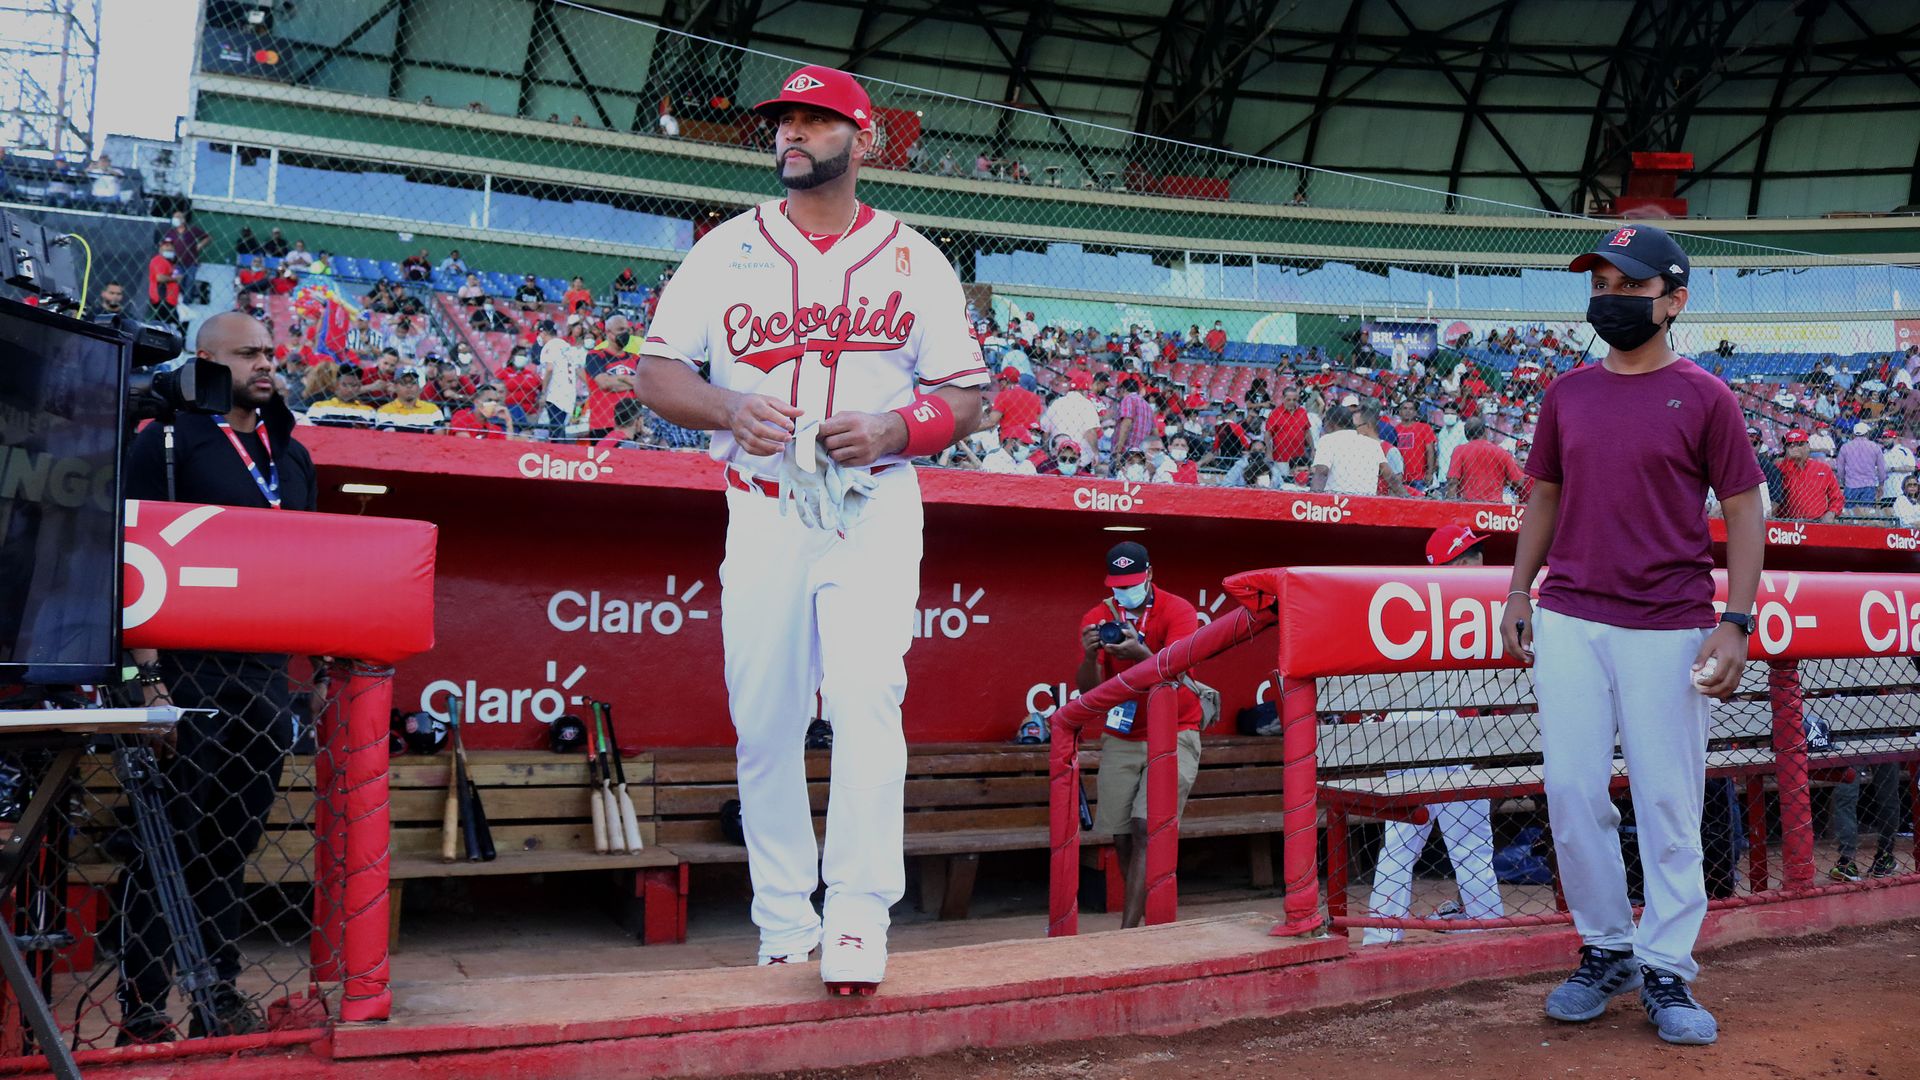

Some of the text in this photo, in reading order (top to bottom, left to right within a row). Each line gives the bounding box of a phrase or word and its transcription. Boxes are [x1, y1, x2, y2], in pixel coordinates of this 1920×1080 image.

[1608, 228, 1636, 247] E
[723, 290, 916, 367] Escogido
[518, 452, 599, 481] Claro
[1073, 487, 1133, 512] Claro
[1291, 499, 1342, 523] Claro
[1475, 510, 1519, 532] Claro
[1768, 527, 1801, 545] Claro
[1886, 533, 1917, 550] Claro
[547, 590, 683, 635] Claro
[1368, 581, 1508, 661] Clar
[420, 680, 565, 724] Claro
